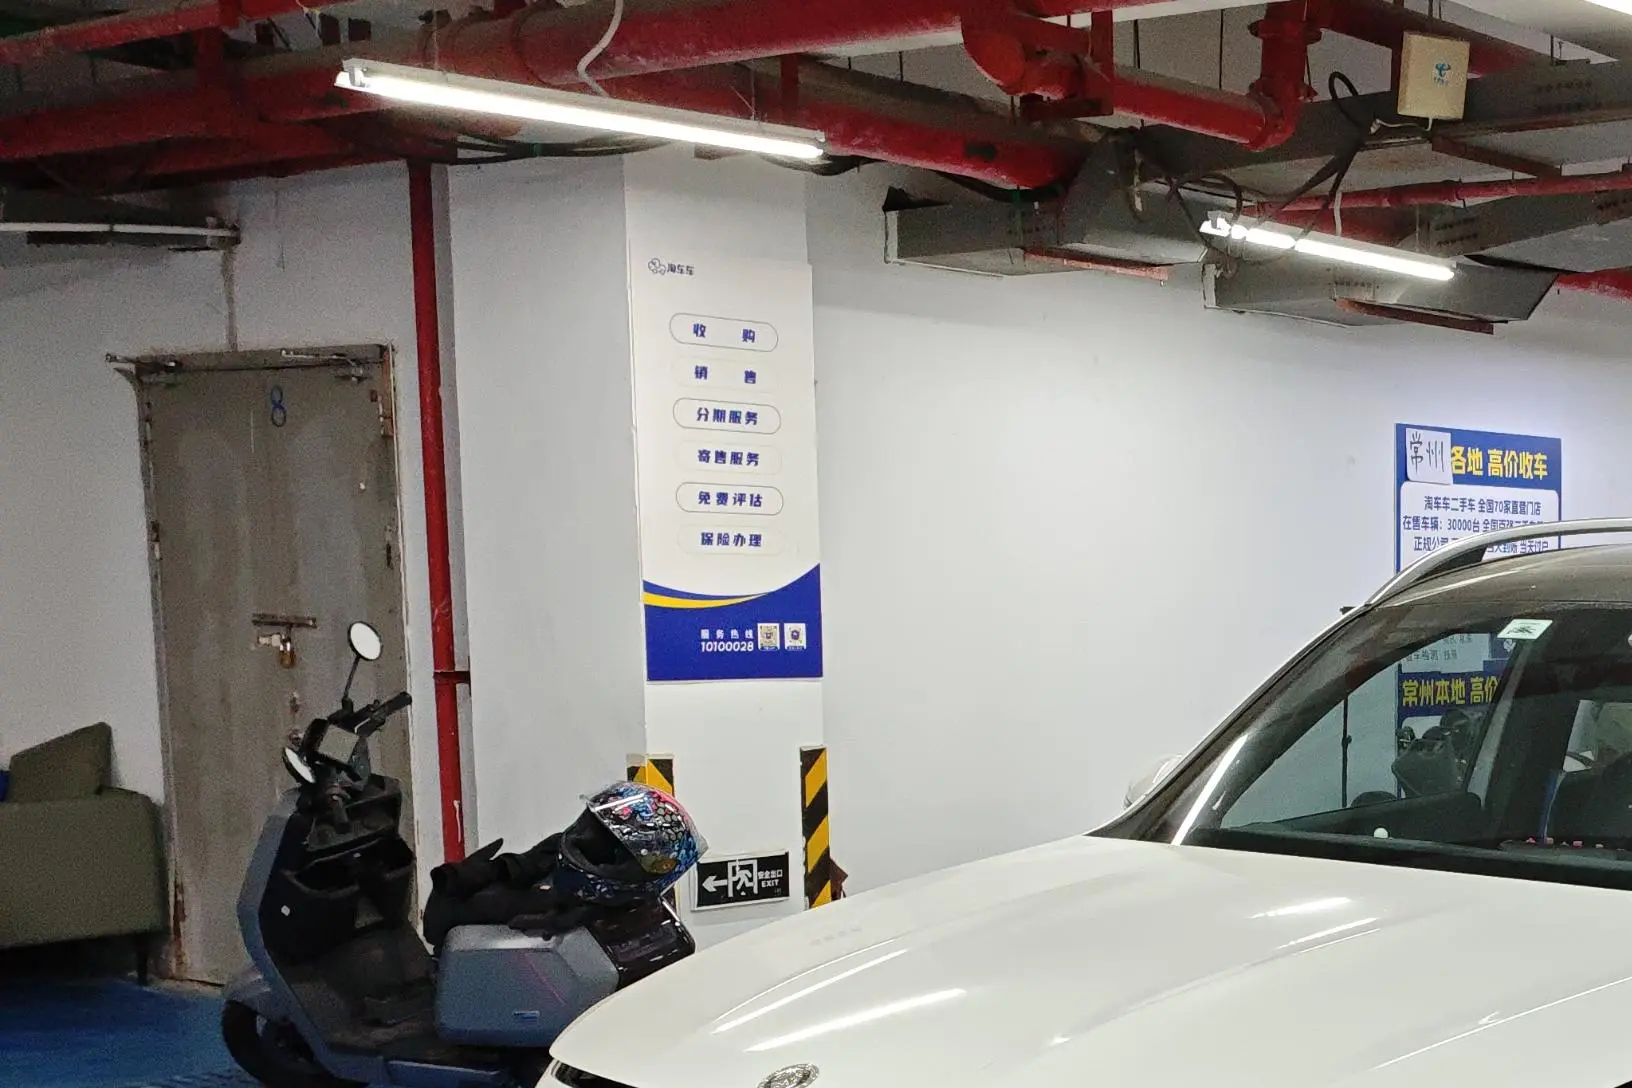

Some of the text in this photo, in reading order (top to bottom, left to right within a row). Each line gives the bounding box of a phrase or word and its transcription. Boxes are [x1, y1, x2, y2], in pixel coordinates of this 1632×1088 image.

[692, 323, 756, 343] 收购
[694, 365, 757, 385] 销售
[696, 407, 759, 426] 分期服务
[697, 449, 760, 467] 寄售服务
[1410, 431, 1444, 474] 常州
[1451, 446, 1548, 480] 各地 高价收车
[698, 490, 763, 507] 免费评估
[701, 532, 762, 547] 保险办理
[701, 641, 754, 652] 10100028
[1403, 678, 1466, 707] 常州本地
[761, 879, 779, 888] EXIT
